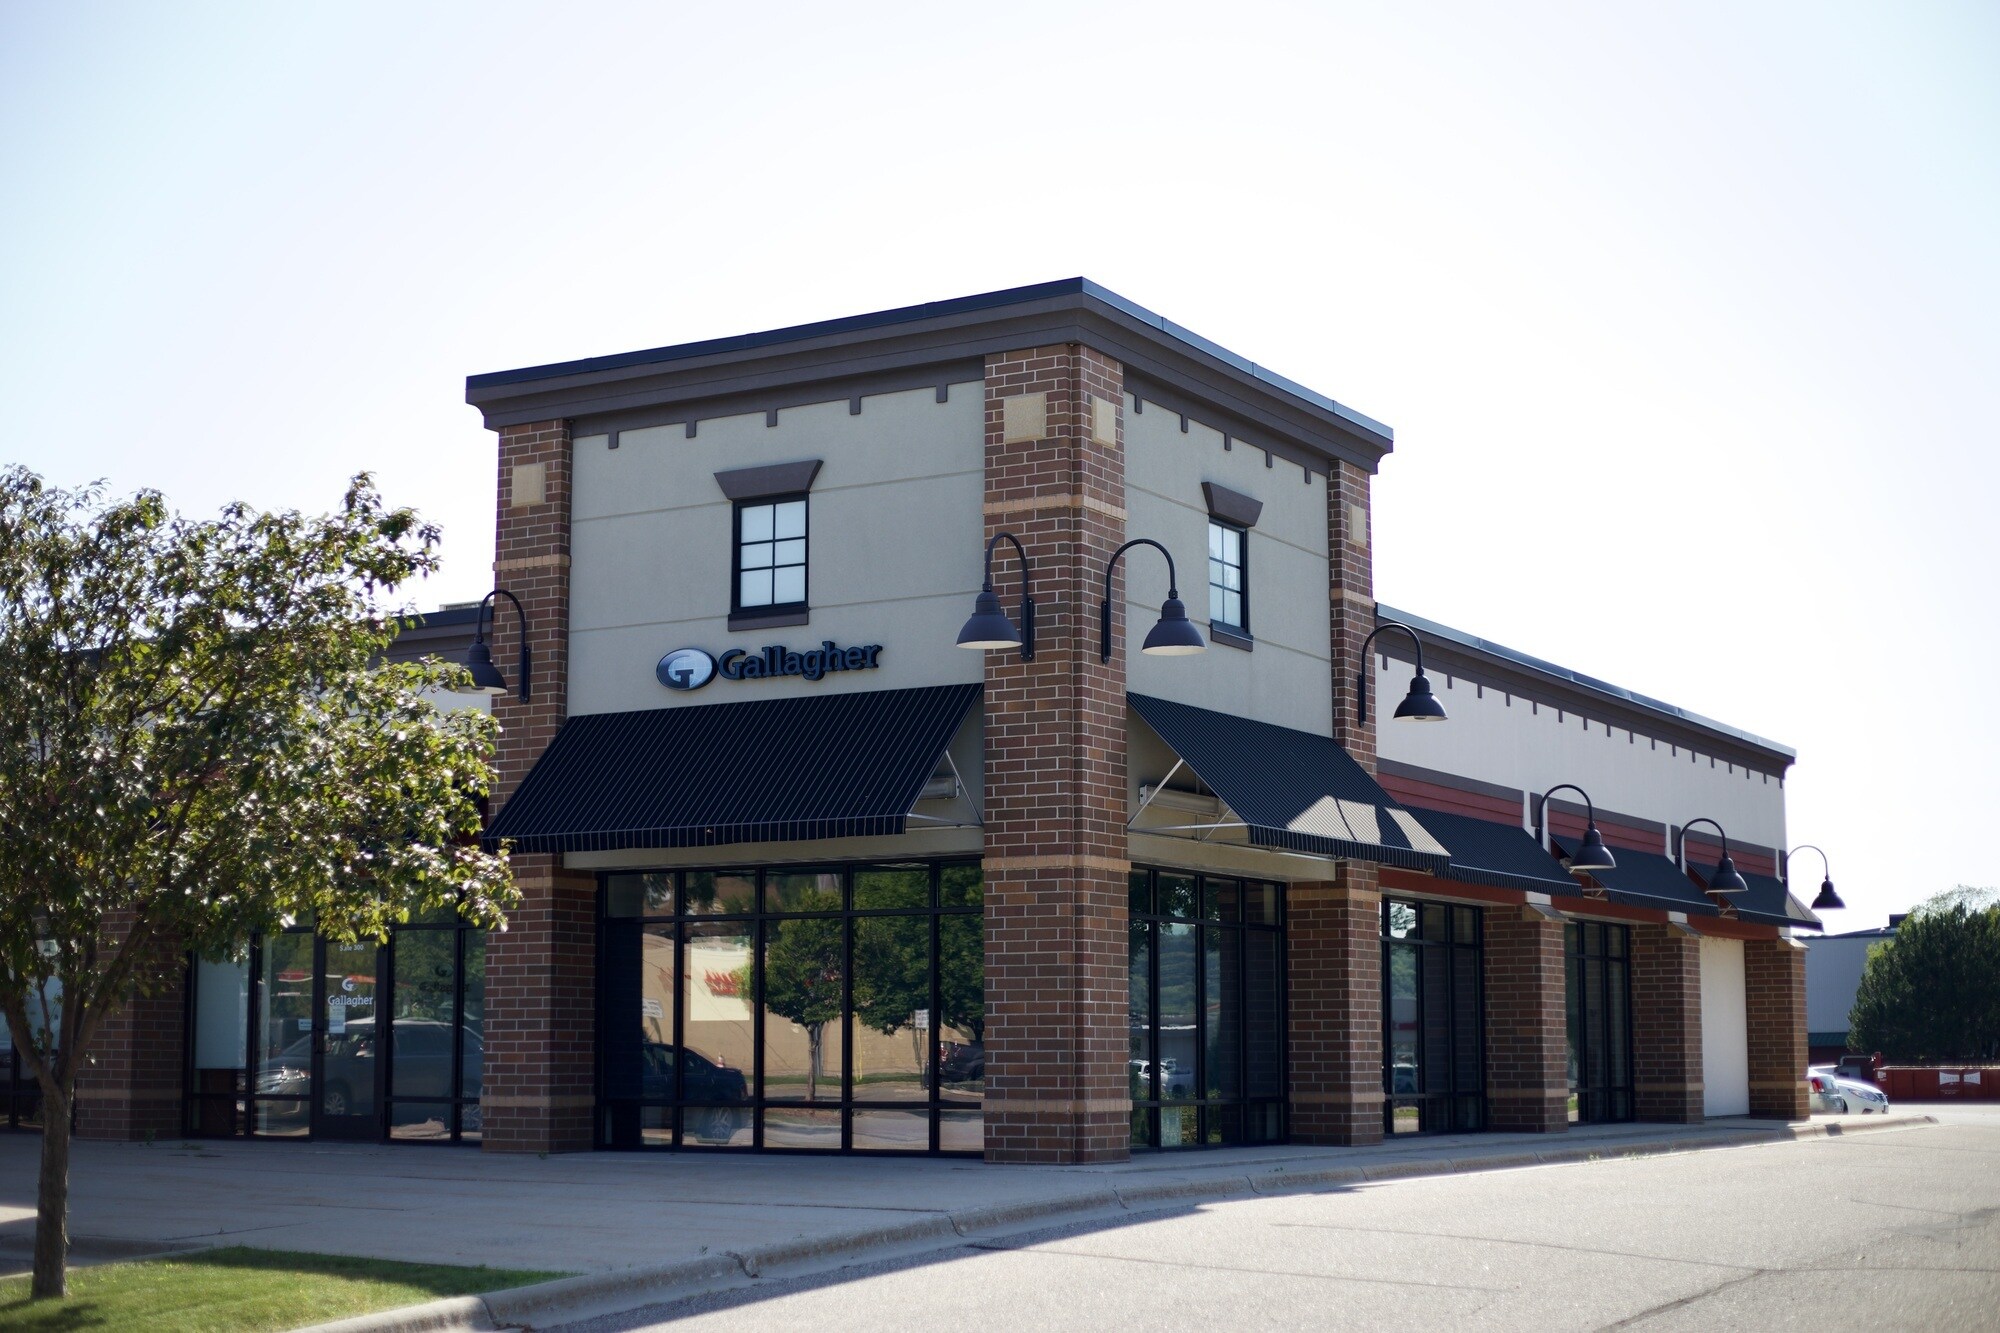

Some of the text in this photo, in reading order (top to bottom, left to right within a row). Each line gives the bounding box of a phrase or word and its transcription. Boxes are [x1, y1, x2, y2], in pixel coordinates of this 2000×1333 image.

[656, 640, 883, 690] G Gallagher
[327, 995, 373, 1007] Gallagher
